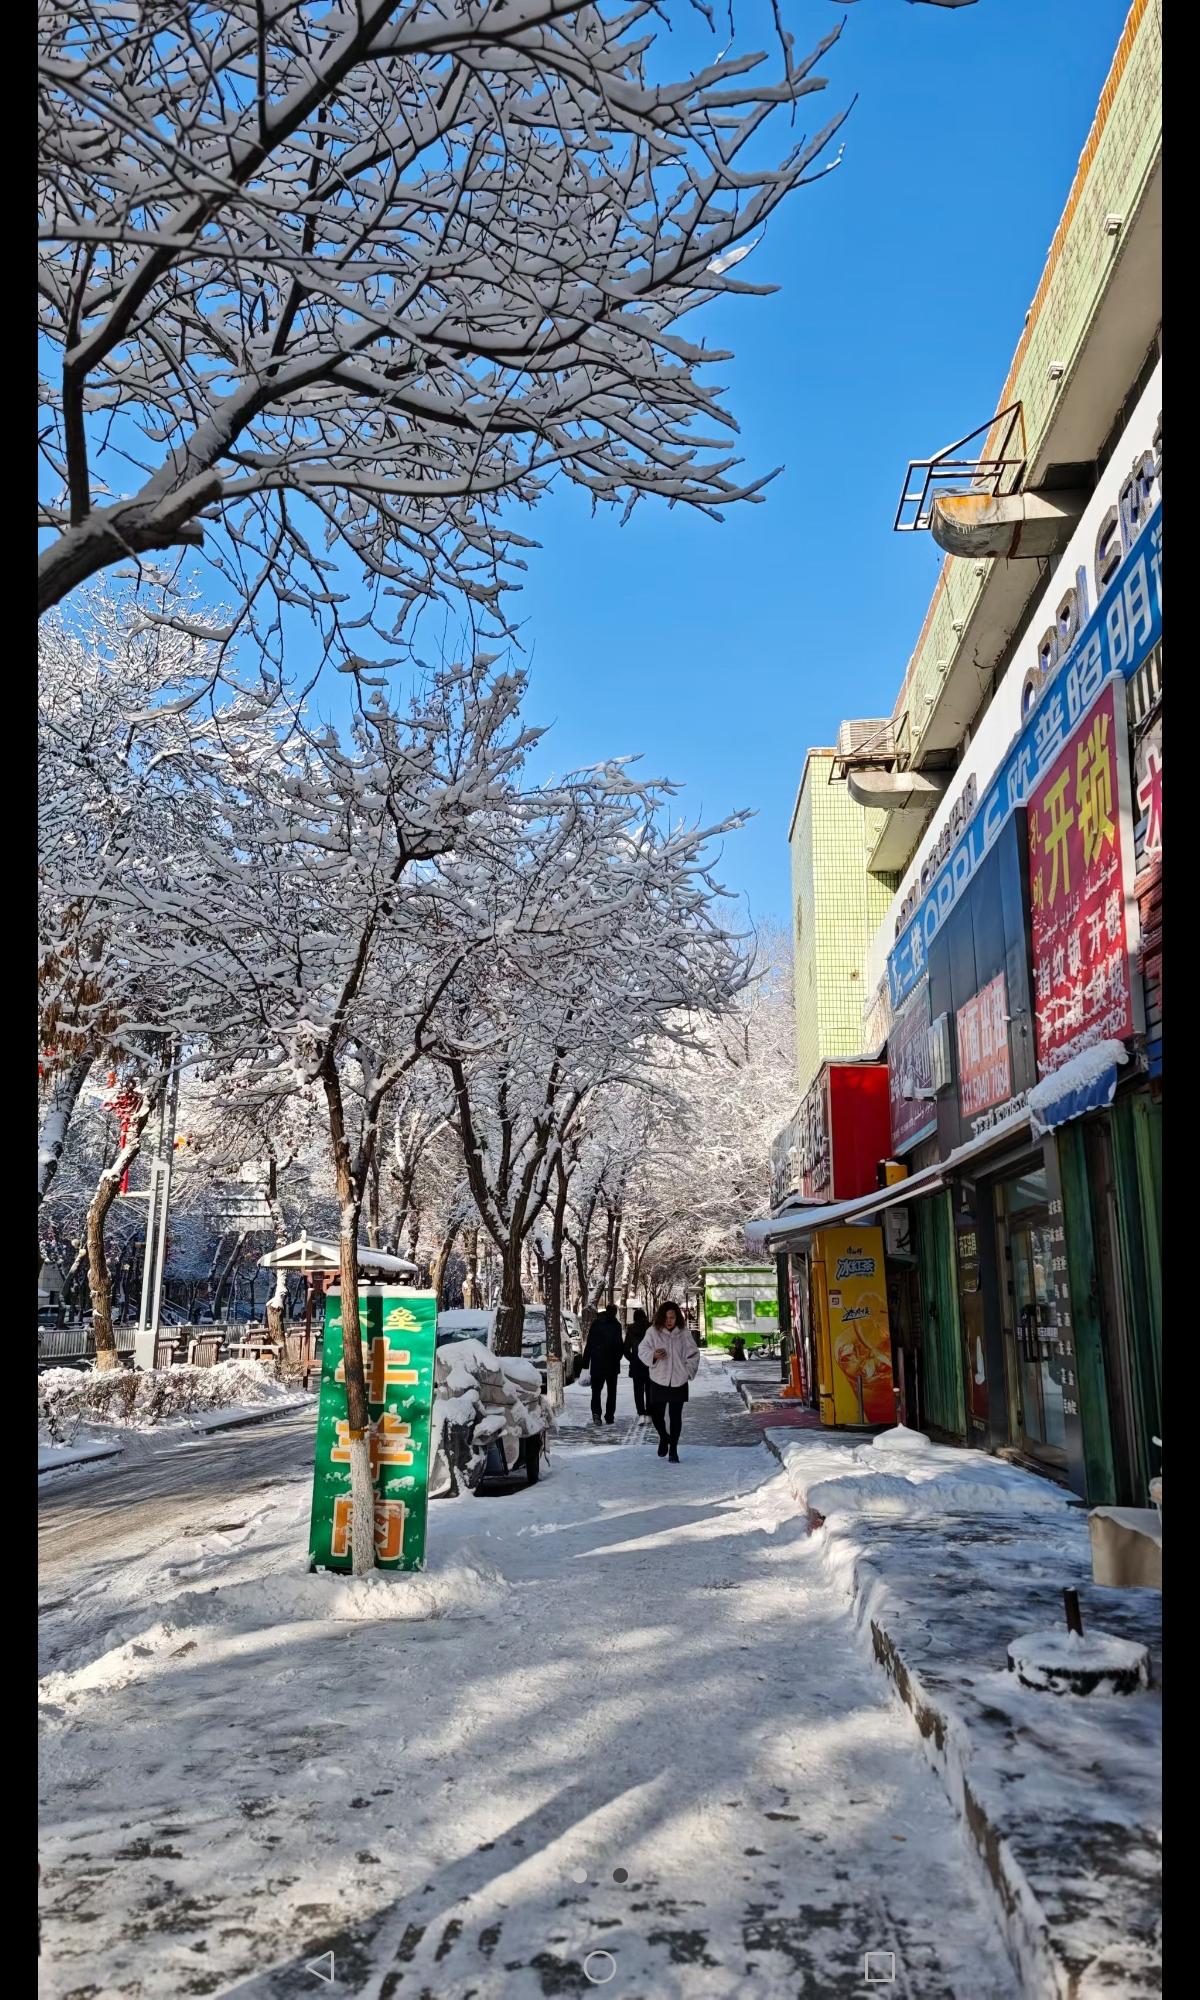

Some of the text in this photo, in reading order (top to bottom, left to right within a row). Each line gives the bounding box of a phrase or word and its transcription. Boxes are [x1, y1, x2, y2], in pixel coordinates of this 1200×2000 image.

[924, 788, 1001, 948] OPPLE
[1044, 713, 1115, 908] 开锁
[1037, 889, 1122, 1000] 指纹锁 开锁
